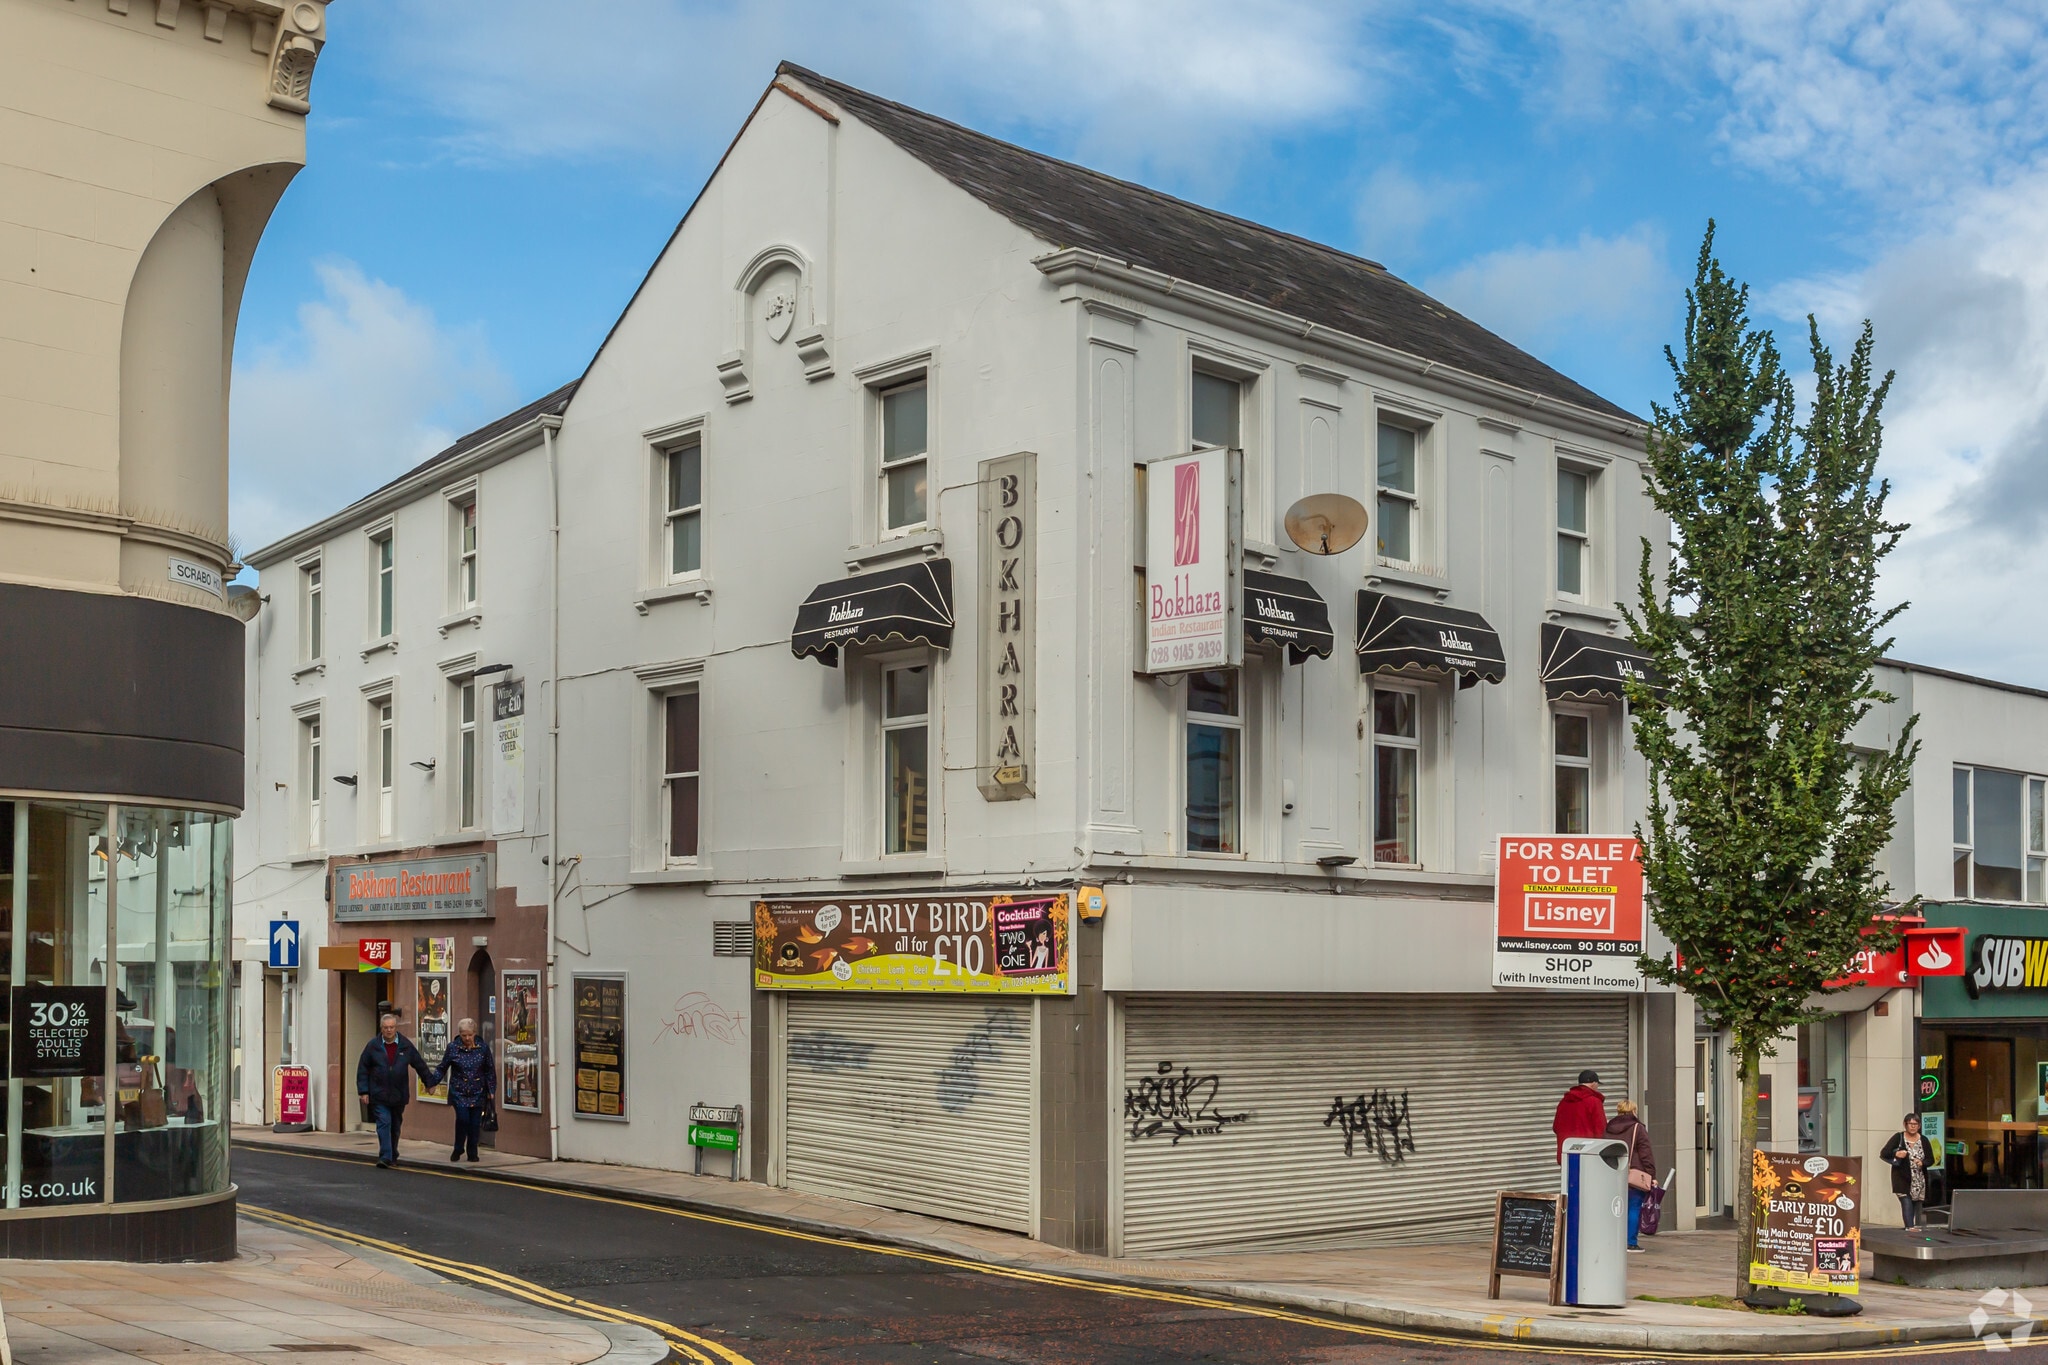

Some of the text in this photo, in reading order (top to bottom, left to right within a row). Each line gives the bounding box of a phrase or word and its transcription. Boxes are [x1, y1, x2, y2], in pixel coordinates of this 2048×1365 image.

[177, 564, 211, 586] SCRABO
[1151, 573, 1221, 620] Bokhara
[828, 600, 864, 623] Bokhara
[995, 474, 1023, 759] BOKHARA
[1255, 598, 1295, 621] Bokhara
[824, 625, 859, 640] RESTAURANT
[1152, 618, 1223, 637] Indian Restaurant
[1261, 626, 1298, 639] RESTAURANT
[1439, 630, 1473, 651] Bokhara
[1151, 640, 1222, 664] 028 9145 2439
[1445, 656, 1477, 668] RESTAURANT
[499, 728, 519, 742] SPECIAL
[501, 741, 517, 753] OFFER
[1505, 842, 1554, 860] FOR
[1560, 843, 1623, 861] SALE
[1528, 865, 1613, 884] TO LET
[349, 866, 471, 900] Bokhara Restaurant
[849, 901, 988, 934] EARLY BIRD
[997, 907, 1041, 922] Cocktails
[1534, 902, 1607, 926] Lisney
[1000, 930, 1026, 945] TWO
[364, 942, 387, 952] JUST
[1008, 944, 1018, 955] for
[1500, 941, 1572, 951] www.lisney.com
[1578, 942, 1593, 951] 90
[1596, 942, 1616, 952] 501
[369, 950, 387, 959] EAT
[895, 934, 984, 977] all for £10
[1001, 954, 1026, 967] ONE
[857, 963, 880, 975] Chicken
[888, 963, 905, 975] Lamb
[913, 964, 928, 975] Beef
[1545, 958, 1593, 972] SHOP
[517, 977, 536, 988] Saturday
[1012, 977, 1024, 987] 028
[1024, 975, 1040, 985] 9145
[1041, 973, 1058, 984] 2439
[1499, 972, 1639, 989] (with Investment Income)
[602, 986, 618, 996] PARTY
[70, 1018, 89, 1027] OFF
[29, 1028, 89, 1038] SELECTED
[517, 1030, 528, 1042] Live
[36, 1039, 82, 1048] ADULTS
[436, 1035, 447, 1051] £10
[37, 1048, 81, 1058] STYLES
[291, 1069, 308, 1077] KING
[691, 1108, 737, 1121] KING STREET
[698, 1130, 715, 1140] Simple
[715, 1132, 734, 1143] Simons
[1770, 1156, 1784, 1165] Simply
[1791, 1157, 1800, 1165] Best
[1769, 1200, 1806, 1214] EARLY
[1807, 1202, 1837, 1217] BIRD
[1793, 1215, 1802, 1223] all
[1803, 1216, 1813, 1224] for
[1814, 1217, 1844, 1237] £10
[1756, 1227, 1814, 1240] Any Main Course
